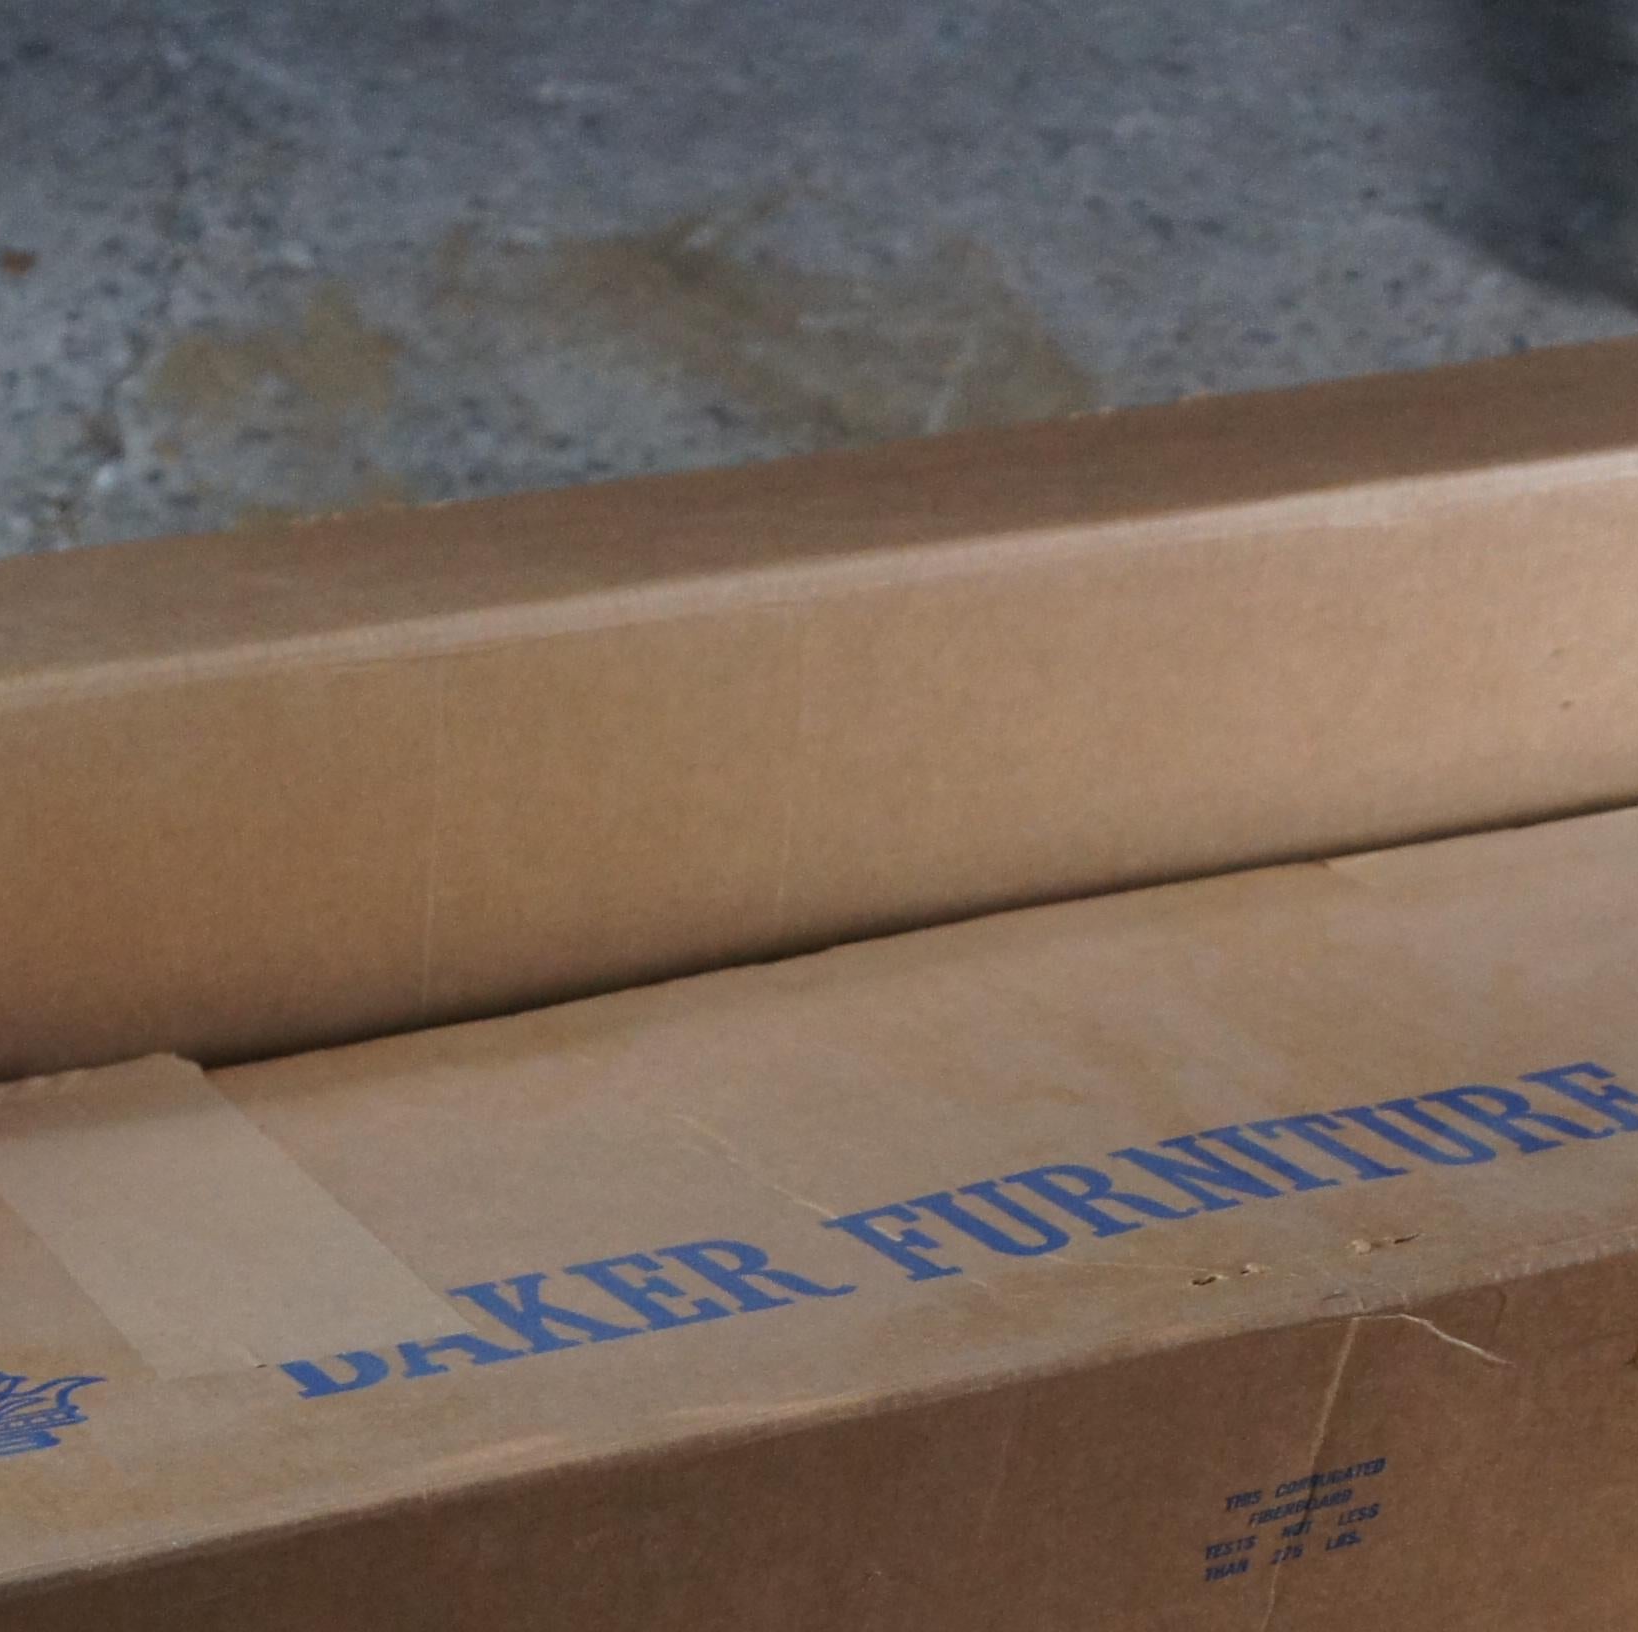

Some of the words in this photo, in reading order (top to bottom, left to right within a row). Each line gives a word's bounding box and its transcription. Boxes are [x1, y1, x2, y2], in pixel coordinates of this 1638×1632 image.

[1225, 1489, 1262, 1512] THIS
[1337, 1502, 1381, 1526] LESS
[1204, 1557, 1251, 1582] THAN
